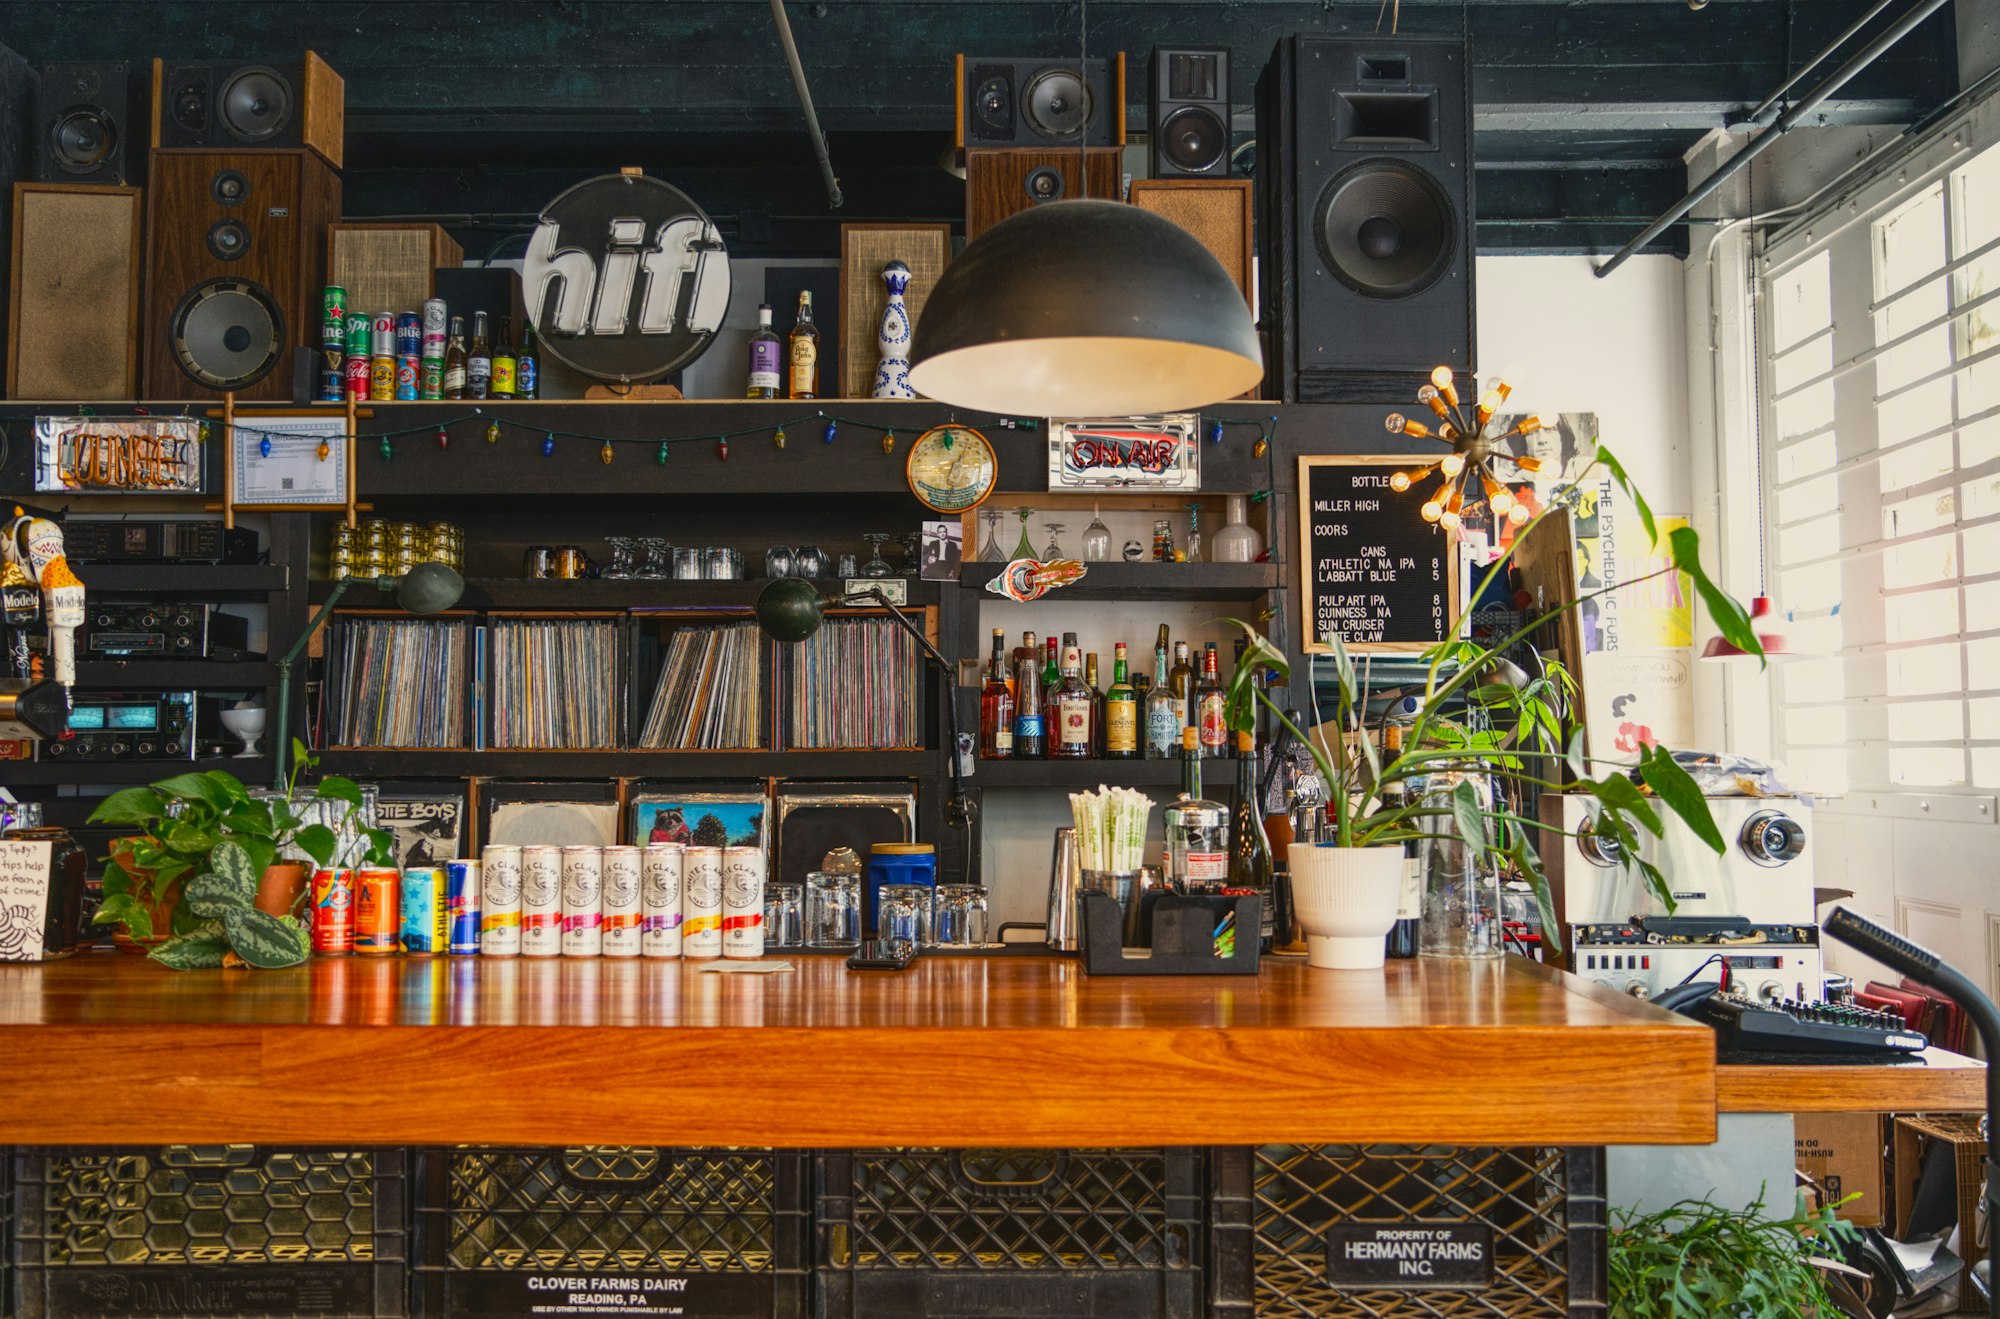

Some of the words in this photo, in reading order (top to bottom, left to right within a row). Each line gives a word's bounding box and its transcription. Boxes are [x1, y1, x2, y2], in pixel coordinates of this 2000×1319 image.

[523, 215, 731, 335] hifi
[398, 325, 421, 338] Blue
[57, 432, 179, 486] LOUNGE
[1073, 440, 1119, 468] ON
[1128, 440, 1174, 467] AIR
[1351, 476, 1389, 488] BOTTLE
[1599, 479, 1612, 508] THE
[1314, 500, 1351, 512] MILLER
[1355, 500, 1380, 512] HIGH
[1314, 525, 1348, 536] COORS
[1431, 524, 1438, 535] 7
[1360, 546, 1386, 558] CANS
[1318, 559, 1371, 570] ATHLETIC
[1378, 558, 1392, 569] NA
[1400, 558, 1415, 569] IPA
[1432, 558, 1439, 569] 8
[1601, 515, 1617, 610] PSYCHEDELIC
[1318, 571, 1364, 582] LABBATT
[1370, 571, 1396, 582] BLUE
[1432, 570, 1439, 581] 5
[3, 593, 39, 608] Modelo
[55, 595, 85, 609] Modelo
[1318, 595, 1345, 606] PULP
[1346, 595, 1366, 606] ART
[1370, 595, 1386, 606] IPA
[1433, 594, 1440, 606] 8
[1318, 607, 1367, 619] GUINNESS
[1376, 607, 1391, 618] NA
[1432, 606, 1442, 618] 10
[1318, 620, 1338, 631] SUN
[1342, 619, 1384, 631] CRUISER
[1434, 619, 1441, 630] 8
[1320, 631, 1350, 642] WTE
[1353, 631, 1383, 642] CLAW
[1435, 630, 1442, 642] 7
[1605, 617, 1618, 652] FURS
[1151, 714, 1174, 725] FORT
[410, 802, 456, 824] BOYS
[1, 860, 22, 872] tips
[25, 860, 45, 872] help
[12, 873, 35, 885] from
[437, 891, 446, 938] ATHLETIC
[1376, 1230, 1433, 1240] PROPERTY
[1436, 1230, 1452, 1240] OF
[1345, 1242, 1426, 1258] HERMANY
[1428, 1242, 1482, 1260] FARMS
[1399, 1260, 1433, 1275] INC.
[528, 1277, 587, 1290] CLOVER
[591, 1278, 640, 1290] FARMS
[644, 1279, 688, 1291] DAIRY
[569, 1294, 627, 1305] READING,
[630, 1294, 647, 1304] PA
